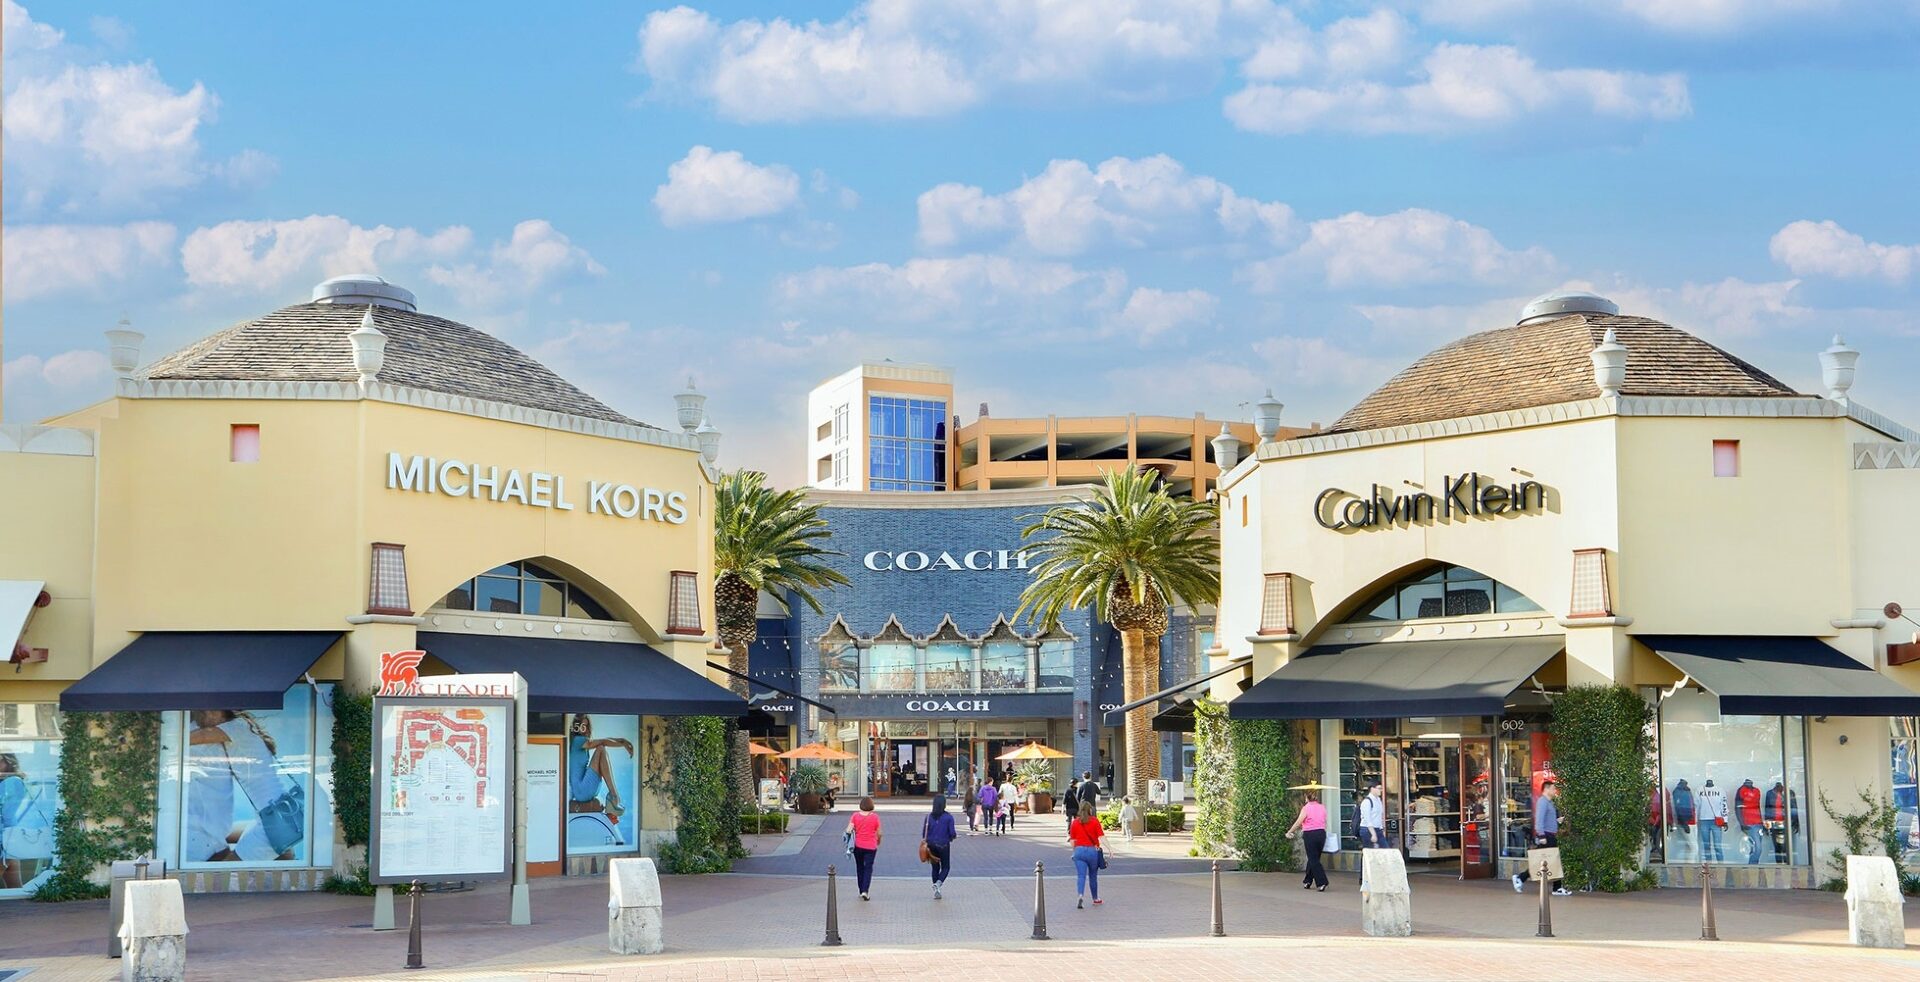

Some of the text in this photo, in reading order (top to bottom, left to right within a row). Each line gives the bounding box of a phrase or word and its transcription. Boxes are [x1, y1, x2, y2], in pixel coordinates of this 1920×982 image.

[386, 452, 688, 525] MICHAEL KORS
[1313, 466, 1544, 530] Calvin Klein
[863, 550, 1029, 571] COACH
[418, 684, 513, 696] CITADEL
[906, 700, 990, 711] COACH
[1502, 719, 1524, 730] 602
